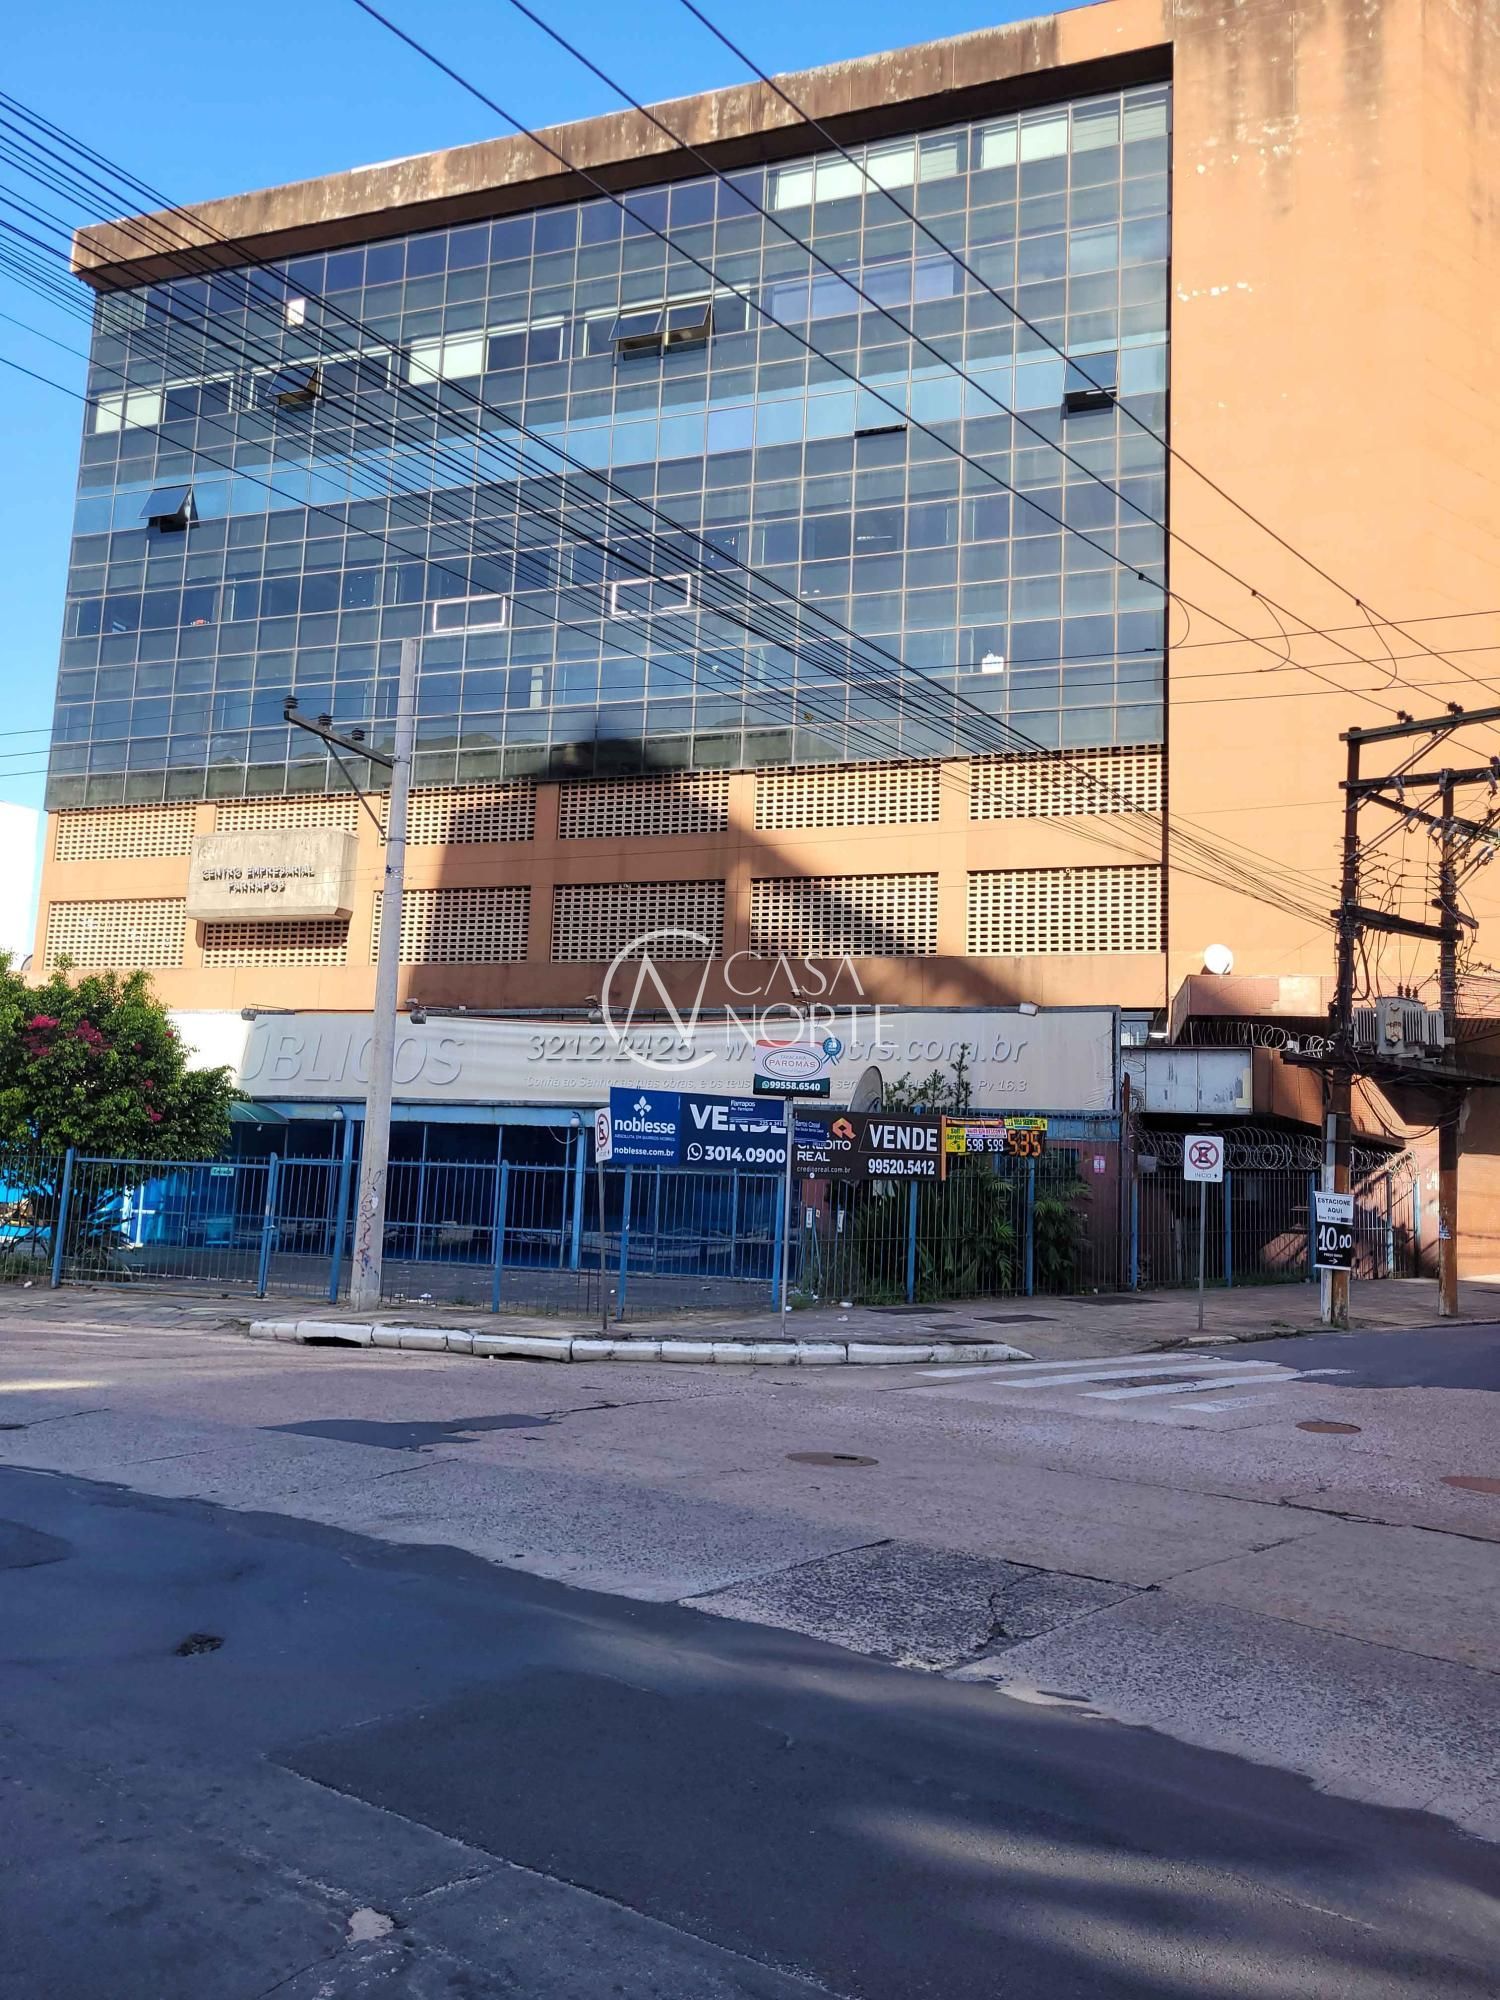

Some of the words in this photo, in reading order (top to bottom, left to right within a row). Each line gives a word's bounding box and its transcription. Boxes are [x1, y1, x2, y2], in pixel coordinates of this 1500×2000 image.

[203, 865, 242, 881] CENTRO
[247, 863, 316, 880] EMPRESARIAL
[526, 1034, 697, 1062] 3212.2425
[769, 1060, 816, 1068] PAROMAS
[770, 1081, 821, 1091] 99558.6540
[614, 1116, 676, 1134] noblesse
[869, 1124, 938, 1152] VENDE
[614, 1146, 675, 1157] noblesse.com.br
[704, 1145, 786, 1163] 3014.0900
[797, 1151, 830, 1162] REAL
[868, 1158, 935, 1175] 99520.5412
[1317, 1198, 1351, 1206] ESTACIONE
[1318, 1224, 1352, 1251] 10,00
